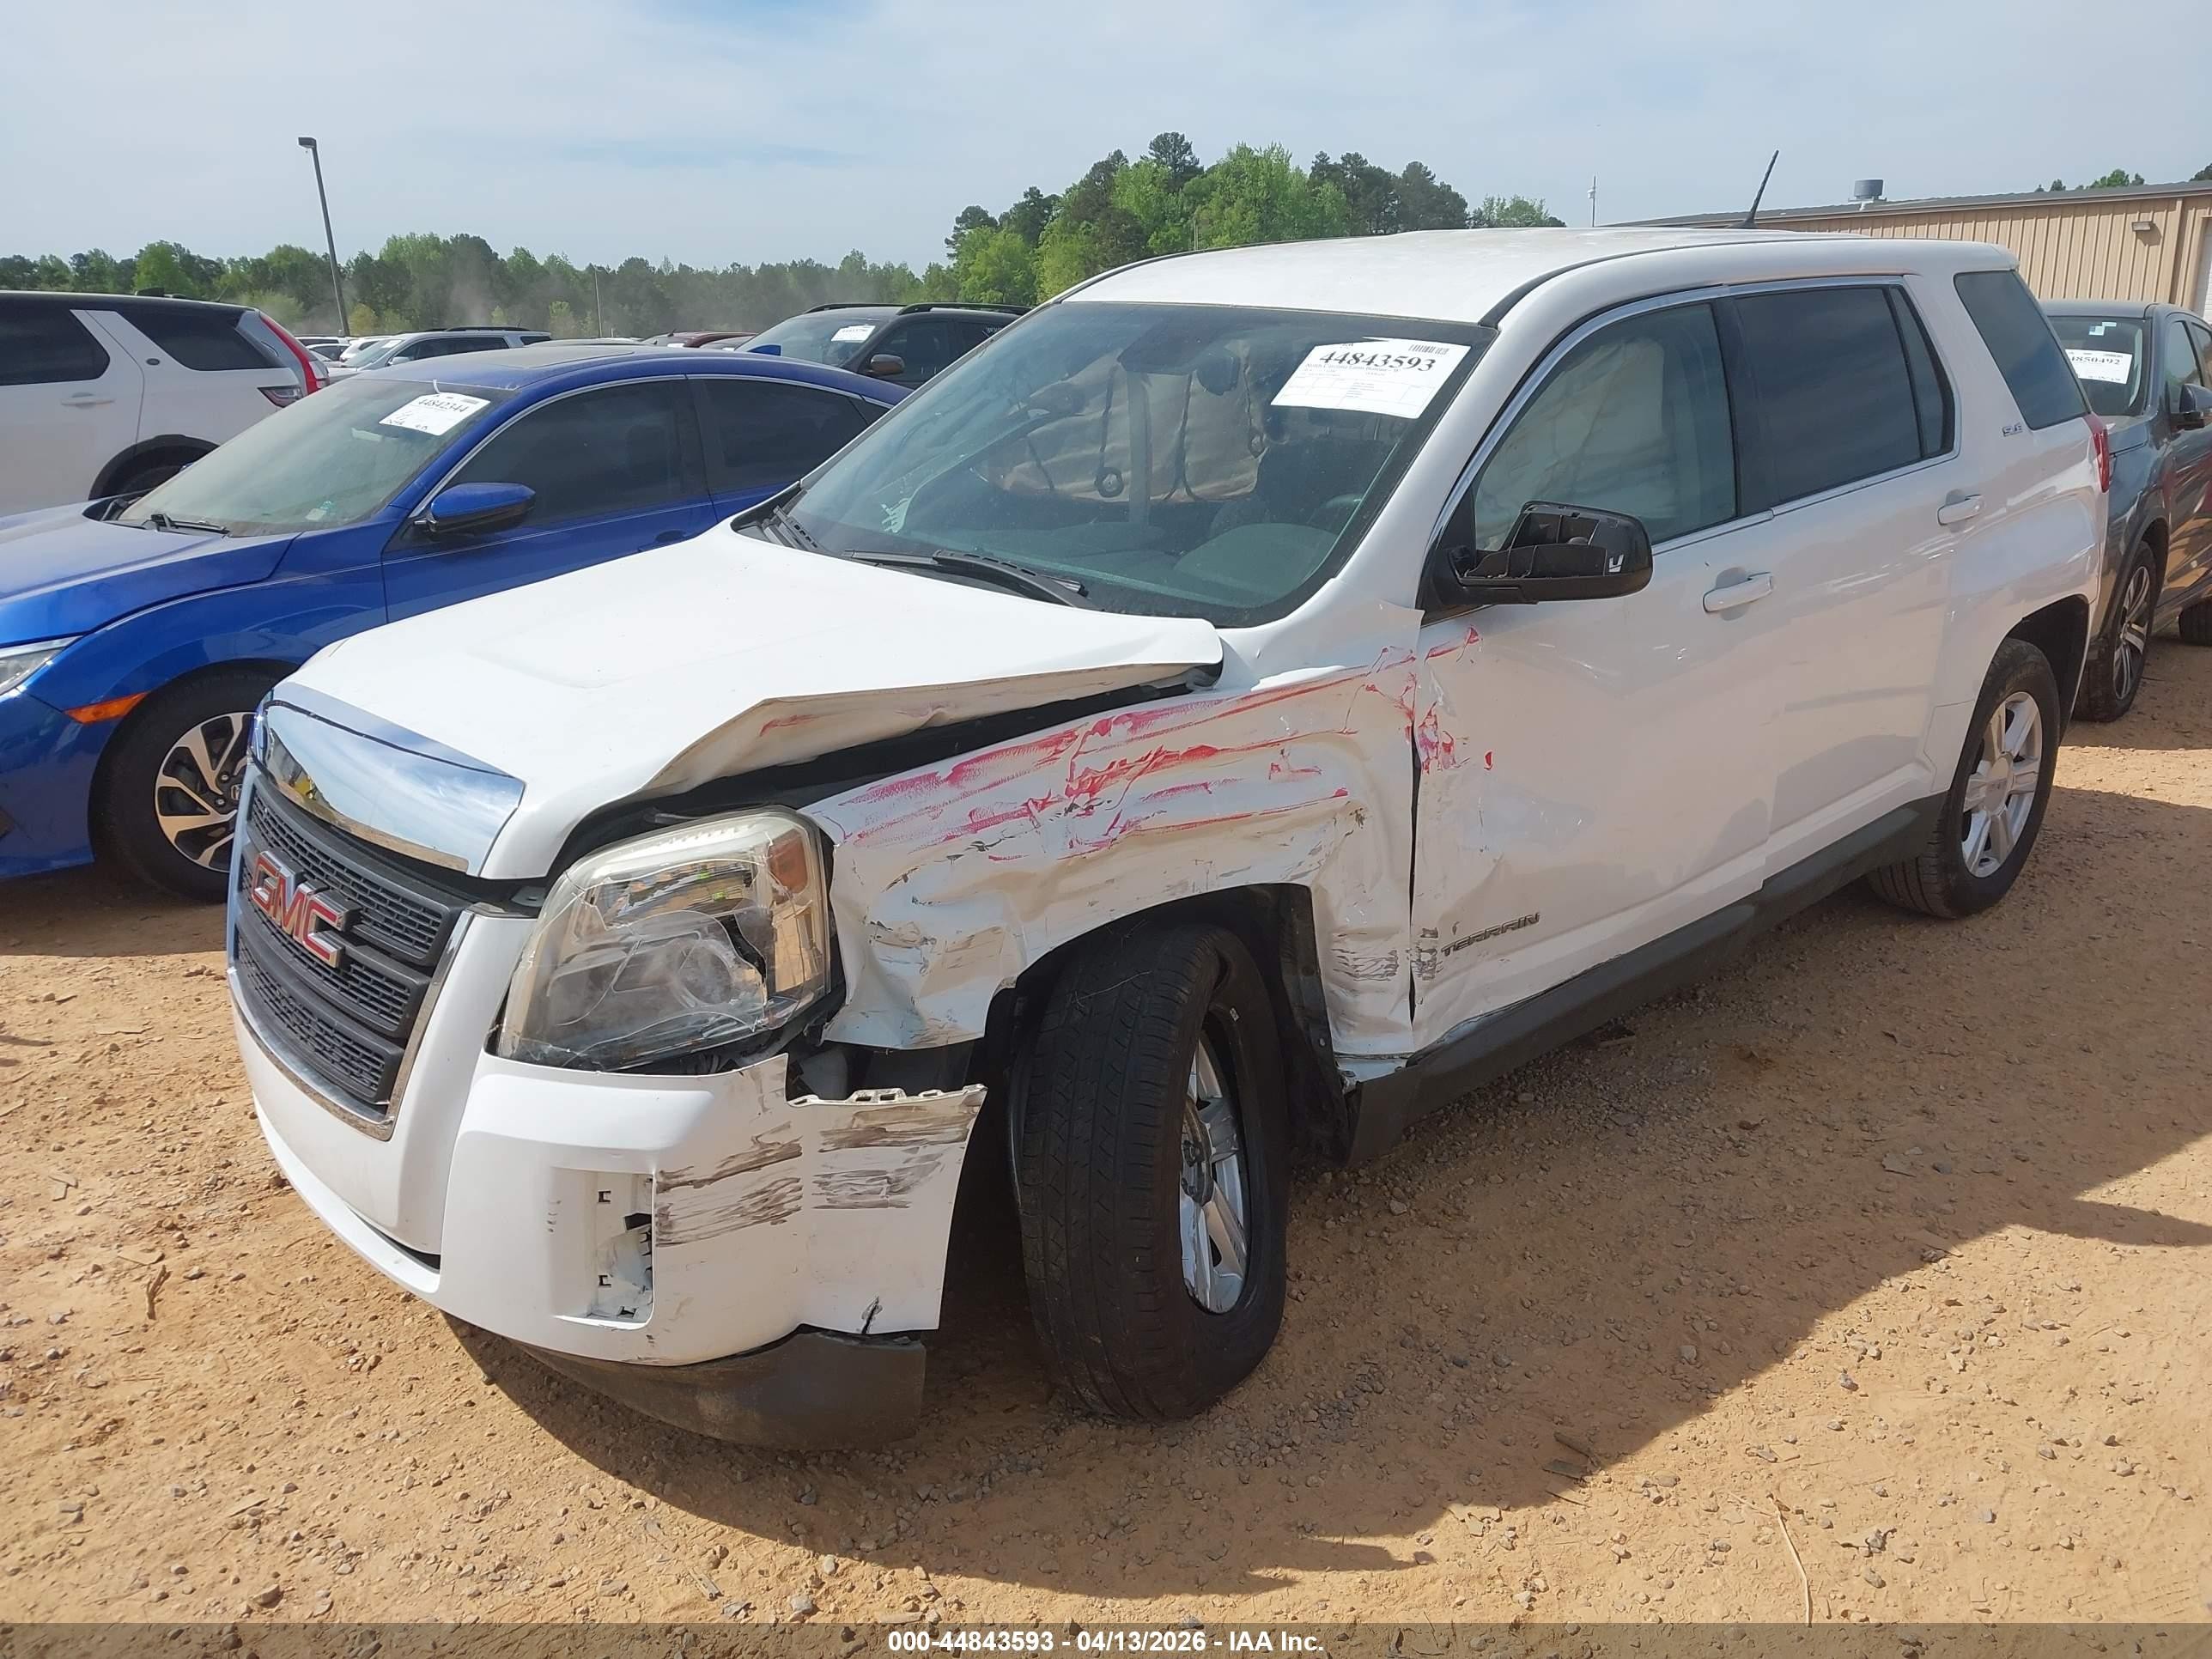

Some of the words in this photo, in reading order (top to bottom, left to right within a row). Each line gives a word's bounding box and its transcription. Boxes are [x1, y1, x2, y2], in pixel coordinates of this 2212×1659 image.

[1320, 351, 1436, 372] 44843593
[251, 851, 345, 968] GMC
[1441, 912, 1541, 957] TERRAIN
